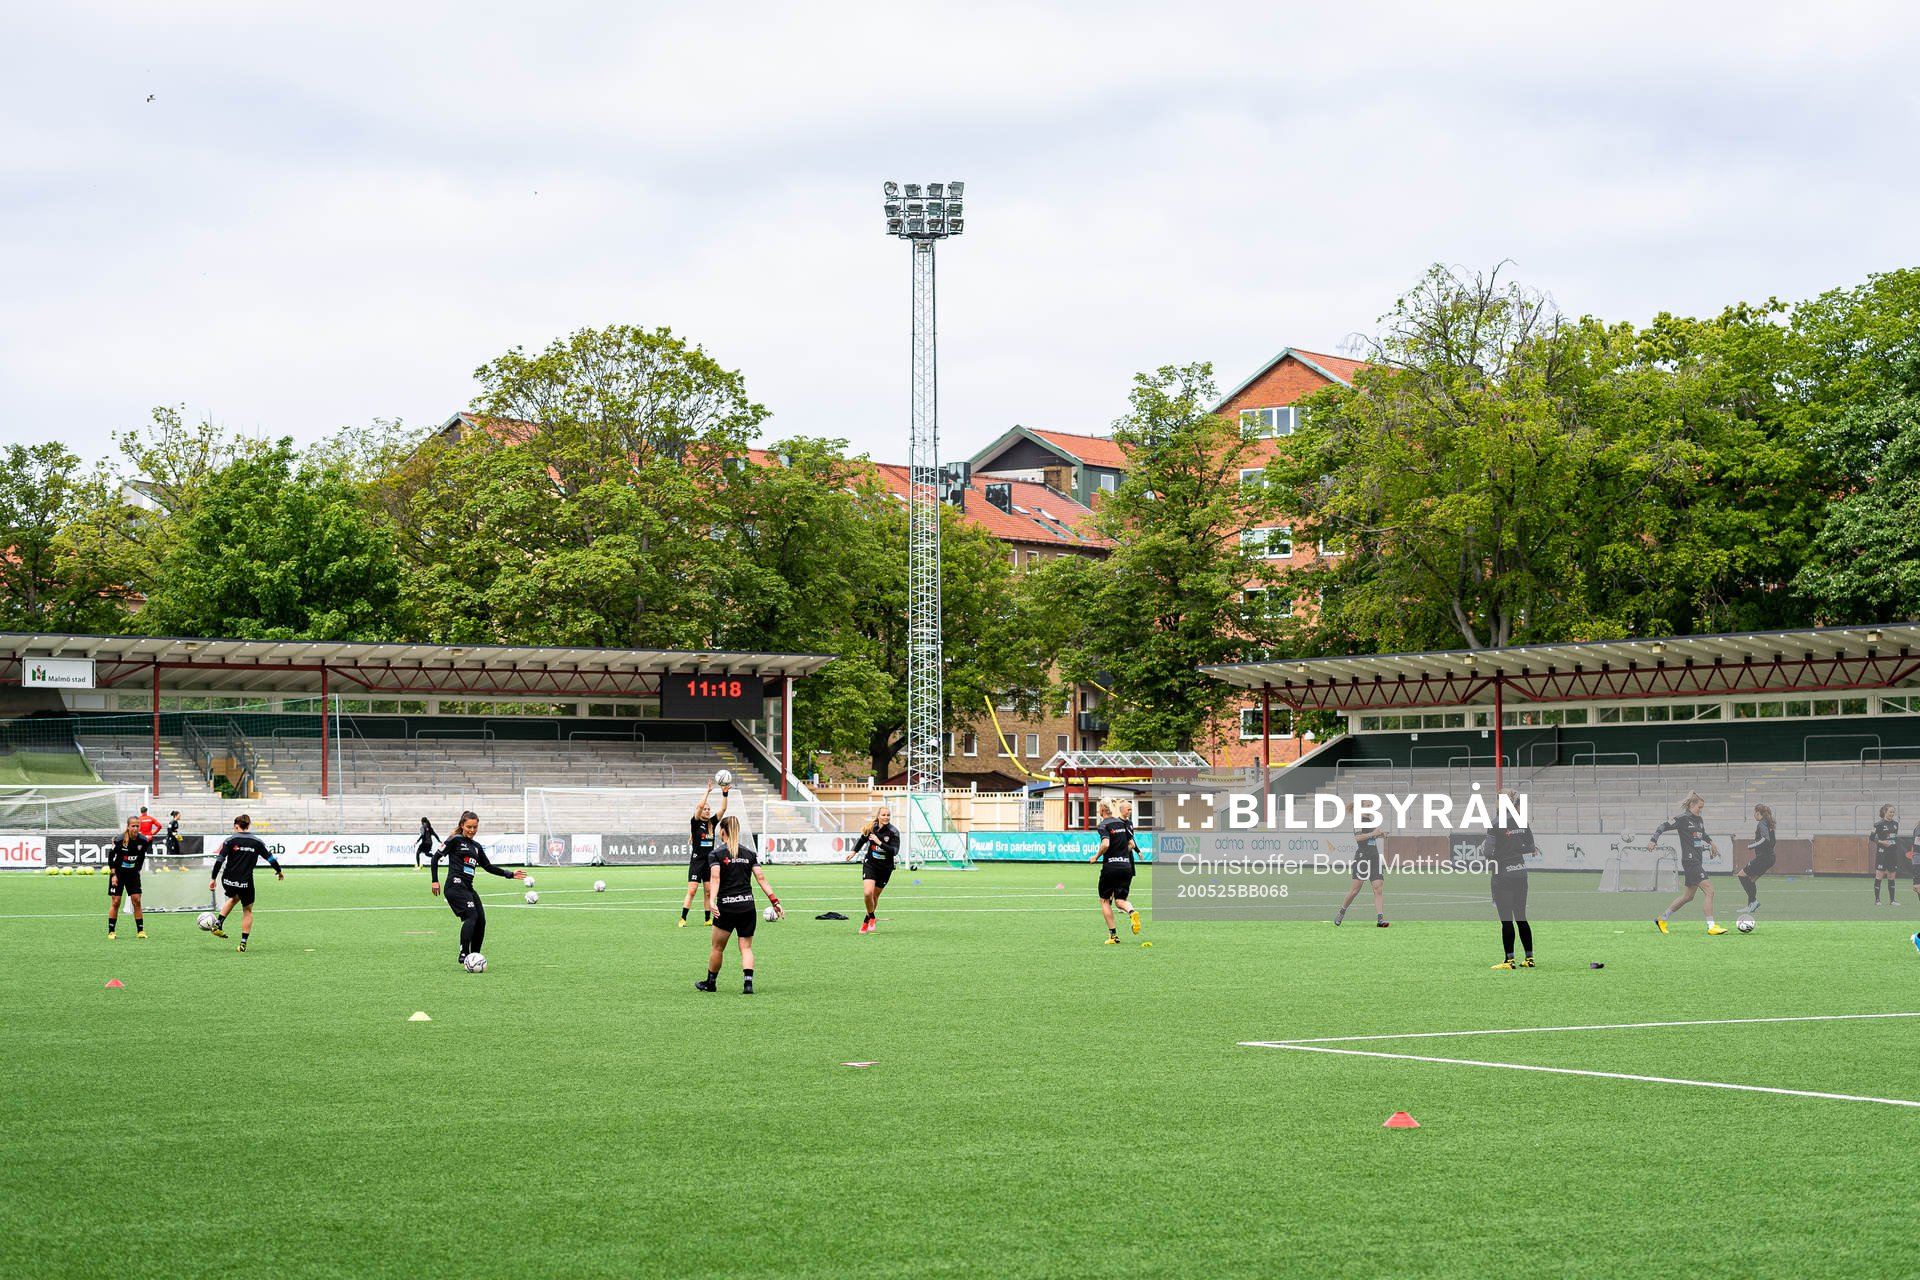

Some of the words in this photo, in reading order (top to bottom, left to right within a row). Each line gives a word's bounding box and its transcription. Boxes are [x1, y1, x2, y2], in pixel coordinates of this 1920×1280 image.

[48, 675, 71, 683] Malmö
[688, 681, 742, 697] 11:18
[333, 843, 370, 854] sesab
[996, 841, 1008, 852] Bra
[1010, 841, 1046, 855] parkering
[1047, 841, 1057, 853] är
[1057, 841, 1081, 853] också
[1163, 838, 1183, 851] MKB
[223, 878, 249, 888] stadium
[722, 894, 753, 904] stadium
